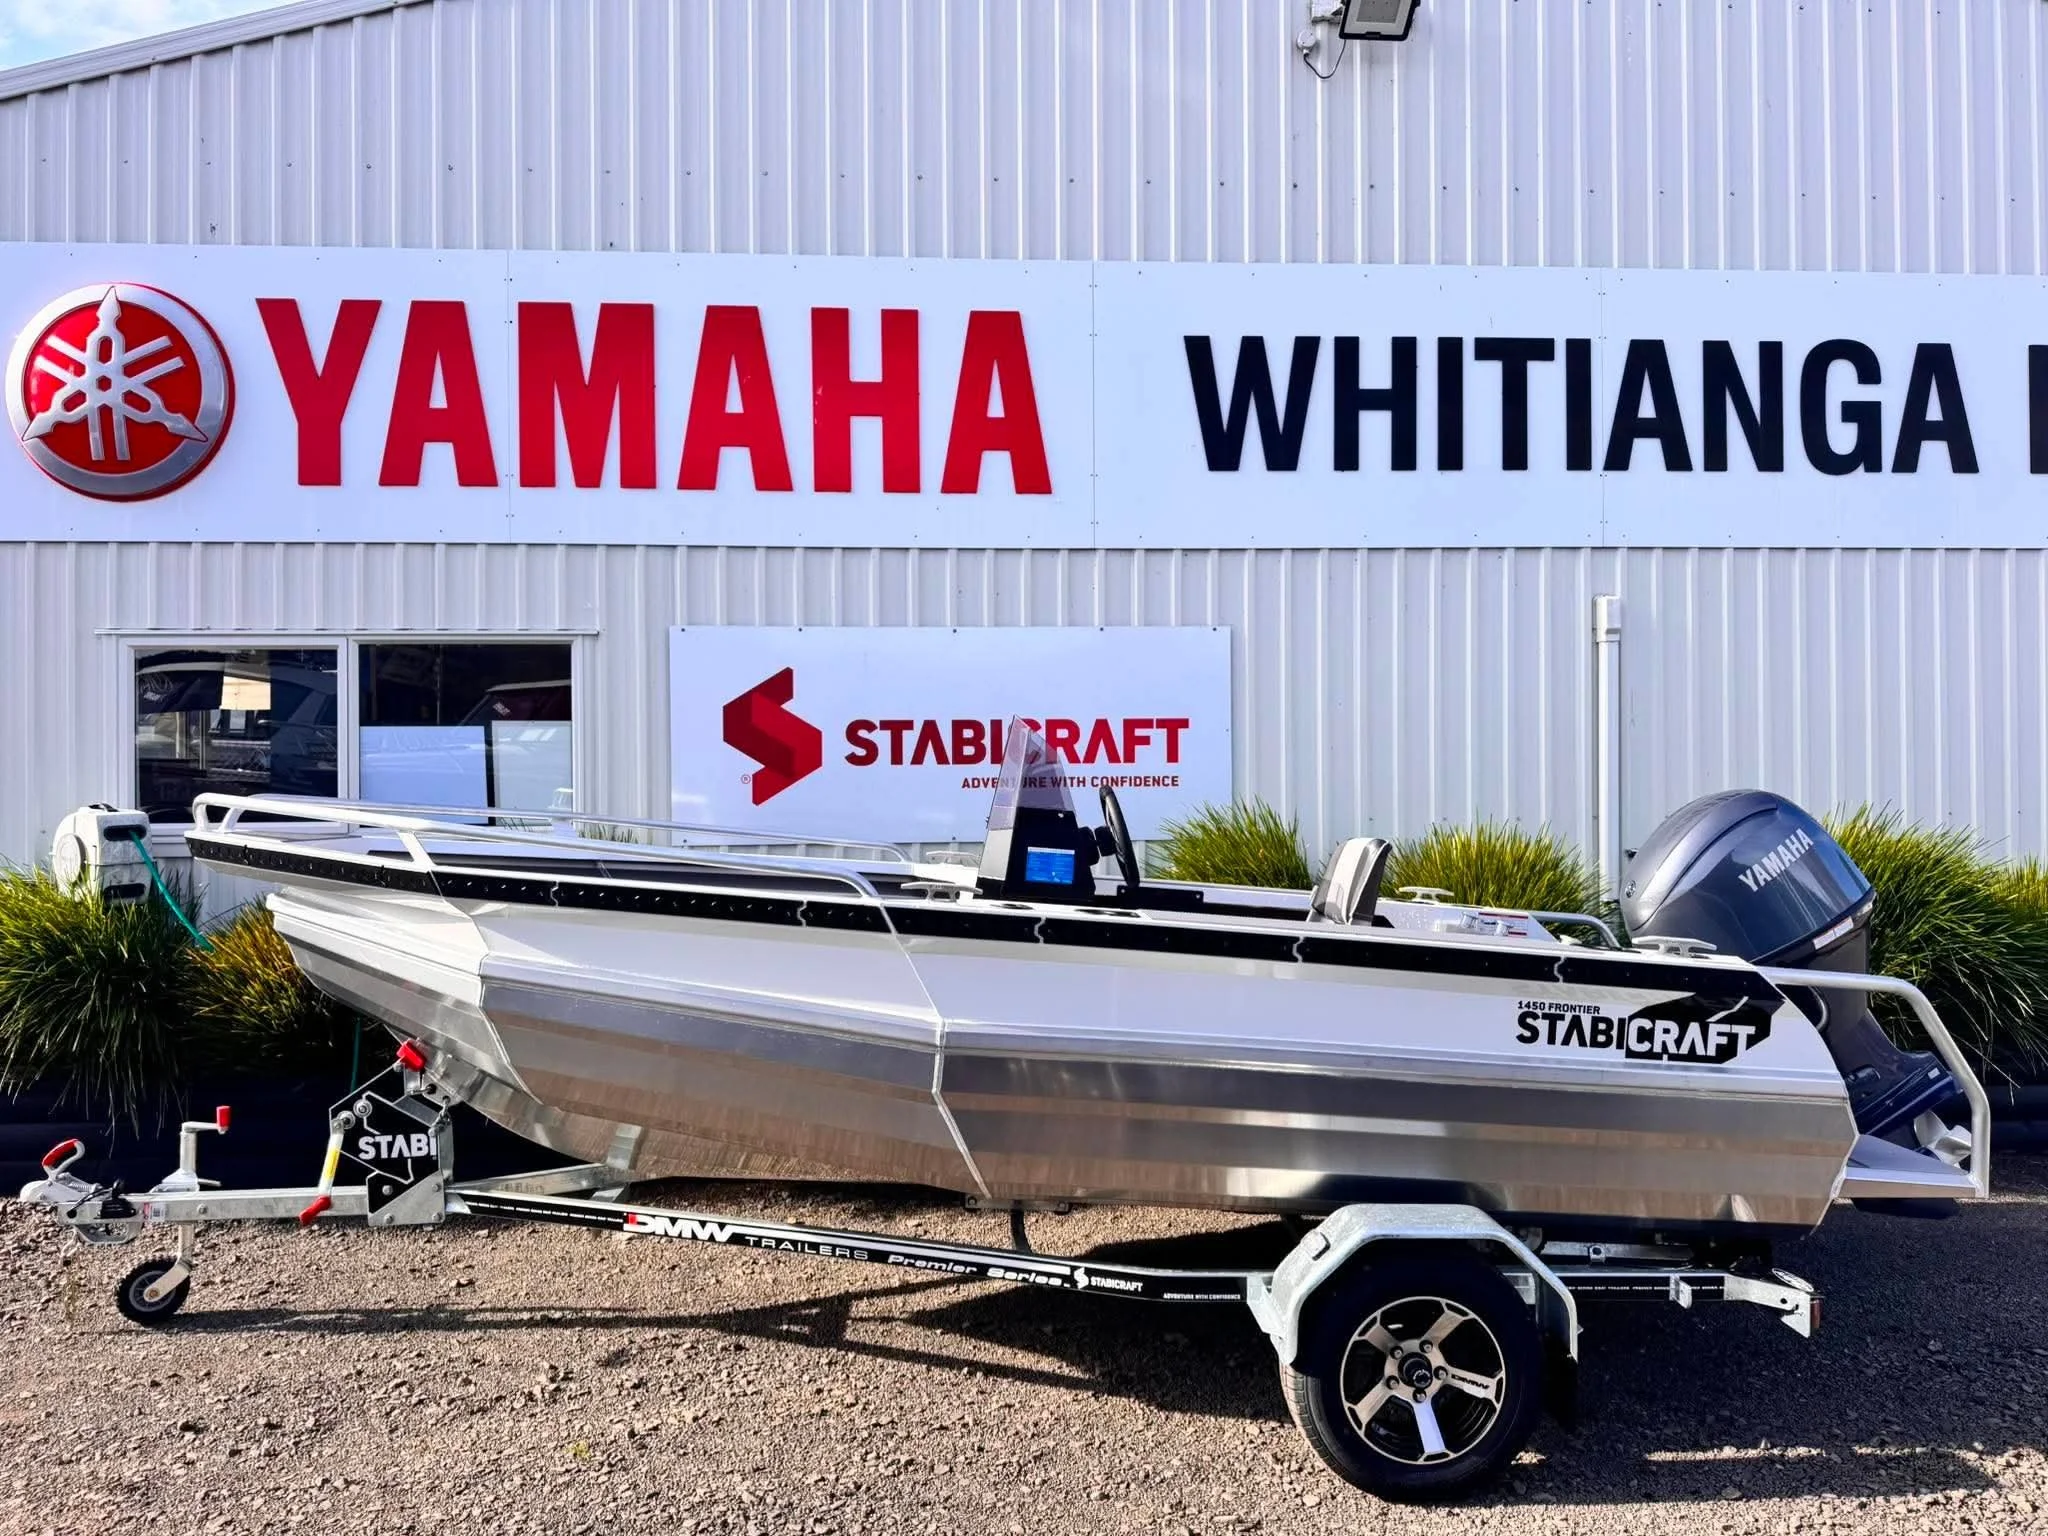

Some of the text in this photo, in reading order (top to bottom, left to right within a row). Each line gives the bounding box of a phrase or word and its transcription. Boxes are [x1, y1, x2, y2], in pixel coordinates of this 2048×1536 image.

[257, 299, 1051, 494] YAMAHA
[1184, 336, 1979, 475] WHITIANGA
[1050, 776, 1087, 788] WITH
[1090, 775, 1180, 788] CONFIDENCE
[1738, 828, 1814, 892] YAMAHA
[1518, 1001, 1601, 1015] 1450 FRONTIER
[1516, 1011, 1756, 1057] STABICRAFT
[358, 1133, 438, 1160] STABI
[623, 1212, 735, 1242] DMW
[744, 1236, 868, 1260] TRAILERS
[887, 1254, 978, 1275] Premier
[1090, 1276, 1144, 1292] STABICRAFT
